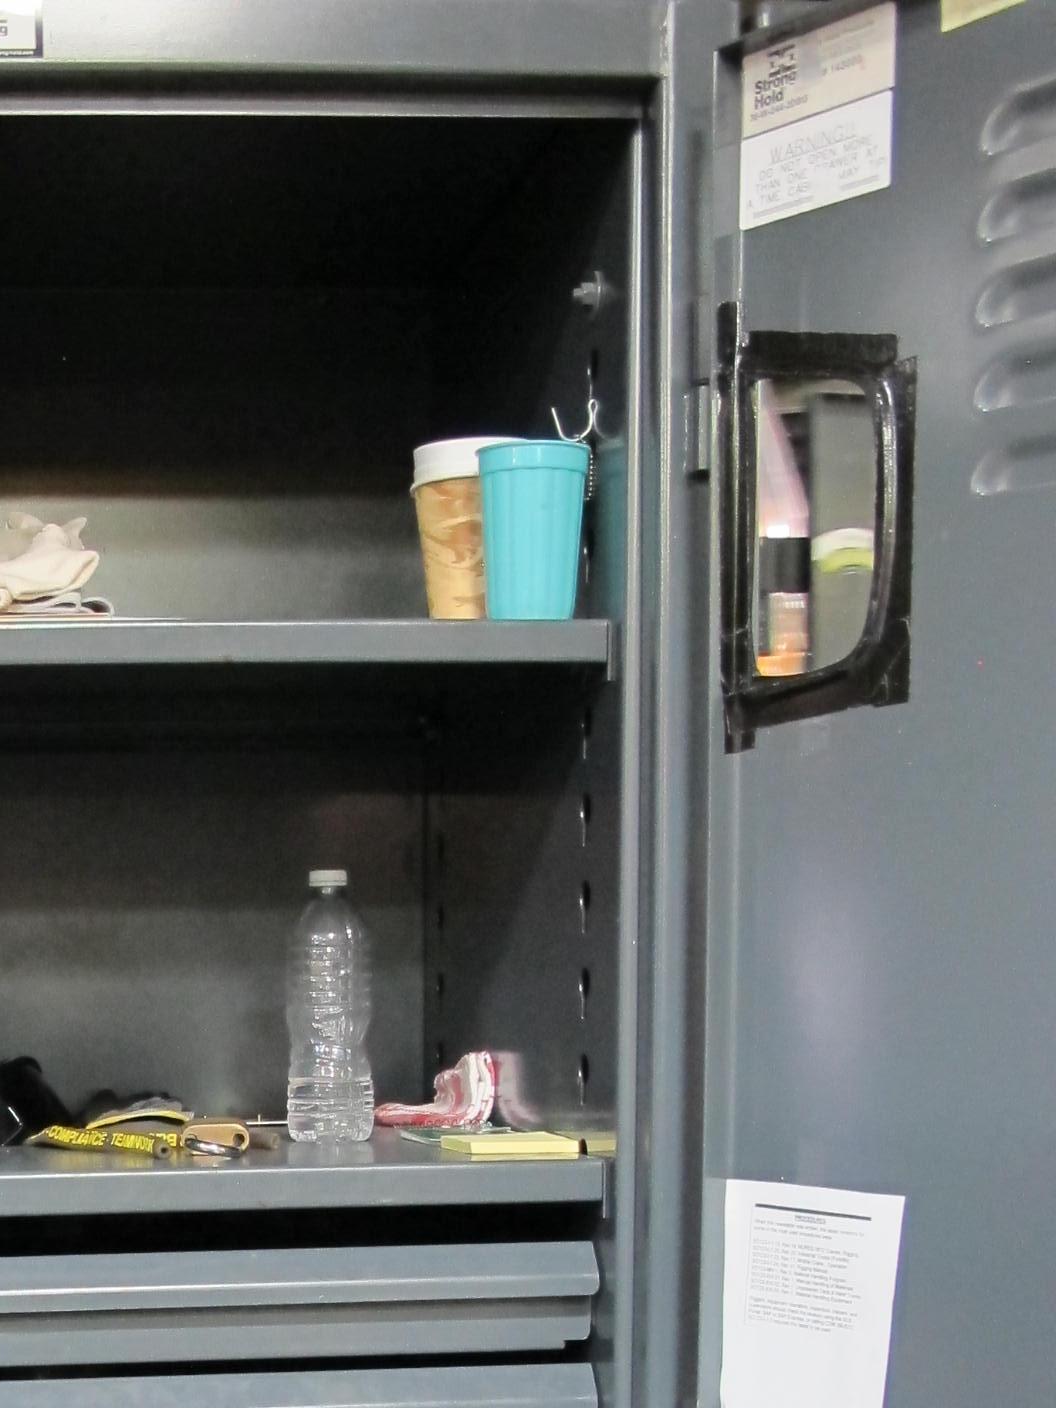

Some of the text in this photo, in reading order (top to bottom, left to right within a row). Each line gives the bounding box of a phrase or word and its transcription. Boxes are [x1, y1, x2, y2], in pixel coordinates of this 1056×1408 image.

[754, 71, 797, 95] Strong
[754, 90, 784, 110] Hold
[48, 1125, 107, 1146] COMPLIANCE
